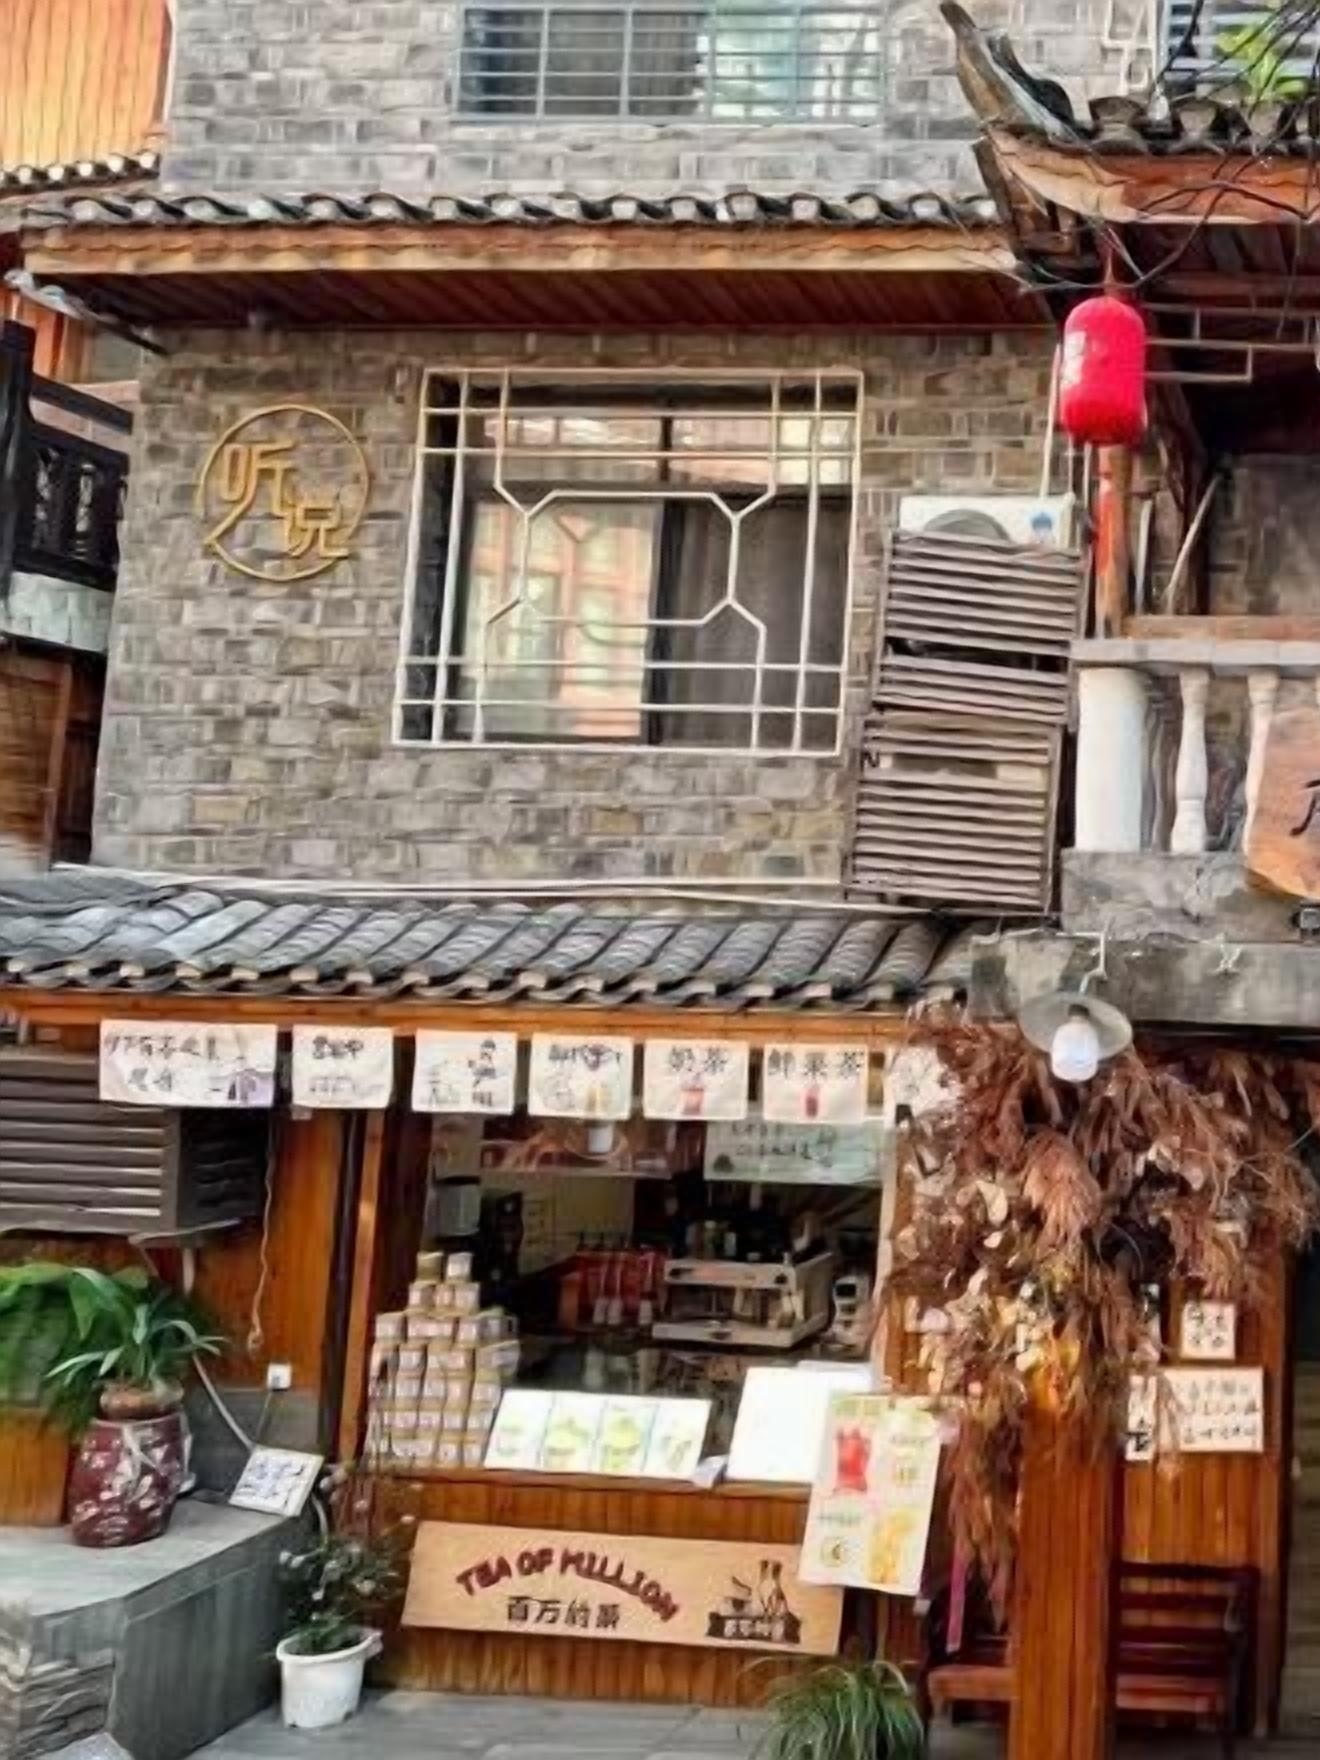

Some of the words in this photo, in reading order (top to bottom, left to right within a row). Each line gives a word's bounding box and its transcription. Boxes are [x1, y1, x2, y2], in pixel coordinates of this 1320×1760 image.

[455, 1555, 513, 1597] TEA
[516, 1547, 555, 1576] OF
[559, 1548, 681, 1623] MILLION
